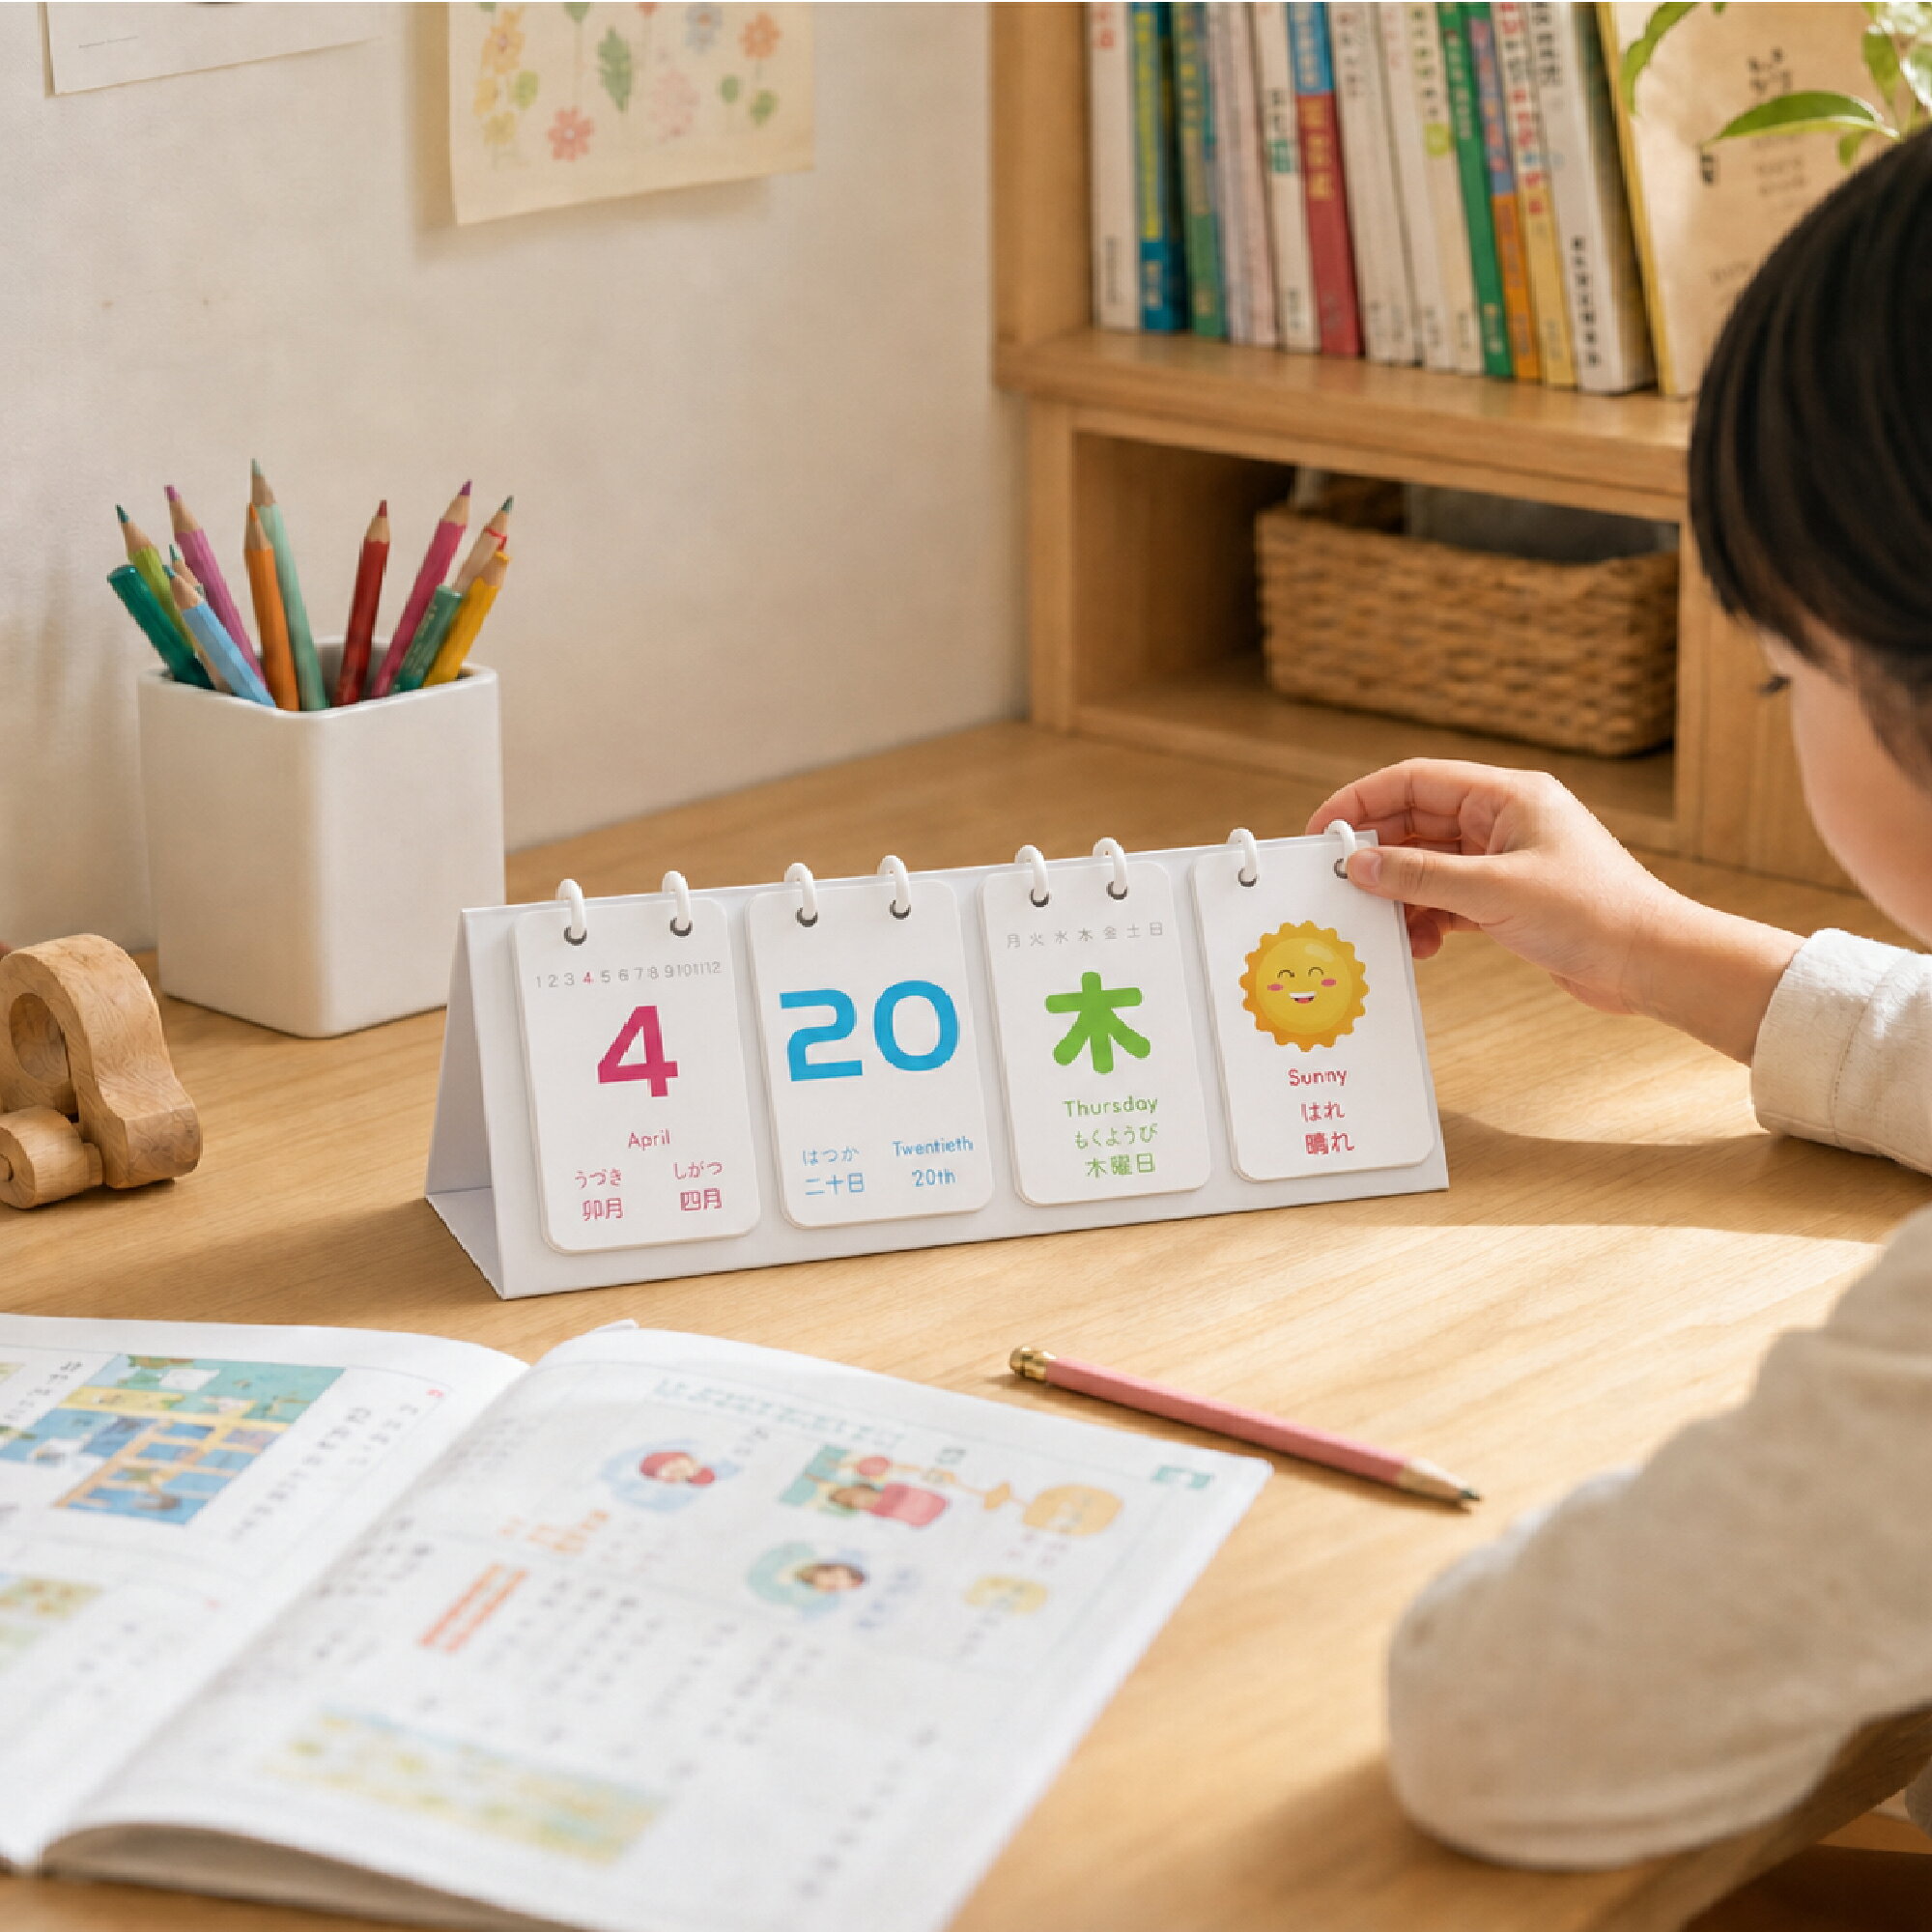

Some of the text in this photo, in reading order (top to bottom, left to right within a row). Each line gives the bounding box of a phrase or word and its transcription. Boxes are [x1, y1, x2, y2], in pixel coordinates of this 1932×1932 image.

[1007, 922, 1163, 950] 月 火 水 木 金 土 日
[548, 974, 559, 988] 2
[564, 973, 576, 986] 3
[582, 971, 594, 984] 4
[600, 969, 611, 983] 5
[618, 968, 630, 981] 6
[634, 966, 644, 980] 7
[647, 966, 660, 980] 8
[665, 964, 674, 979] 9
[780, 980, 960, 1082] 20
[1044, 971, 1151, 1075] 木
[597, 1006, 678, 1097] 4
[1288, 1068, 1348, 1087] Sunny
[1063, 1094, 1158, 1118] Thursday
[1301, 1101, 1346, 1122] はれ
[628, 1128, 670, 1151] April
[892, 1135, 974, 1157] Twentieth
[1075, 1122, 1158, 1150] もくようび
[1305, 1130, 1354, 1155] 晴れ
[802, 1146, 860, 1167] はつか
[1085, 1152, 1156, 1179] 木曜日
[575, 1168, 622, 1189] うづき
[673, 1160, 724, 1180] しがつ
[911, 1167, 956, 1188] 20th
[805, 1172, 866, 1196] 二十日
[582, 1197, 624, 1222] 卯月
[680, 1188, 723, 1212] 四月
